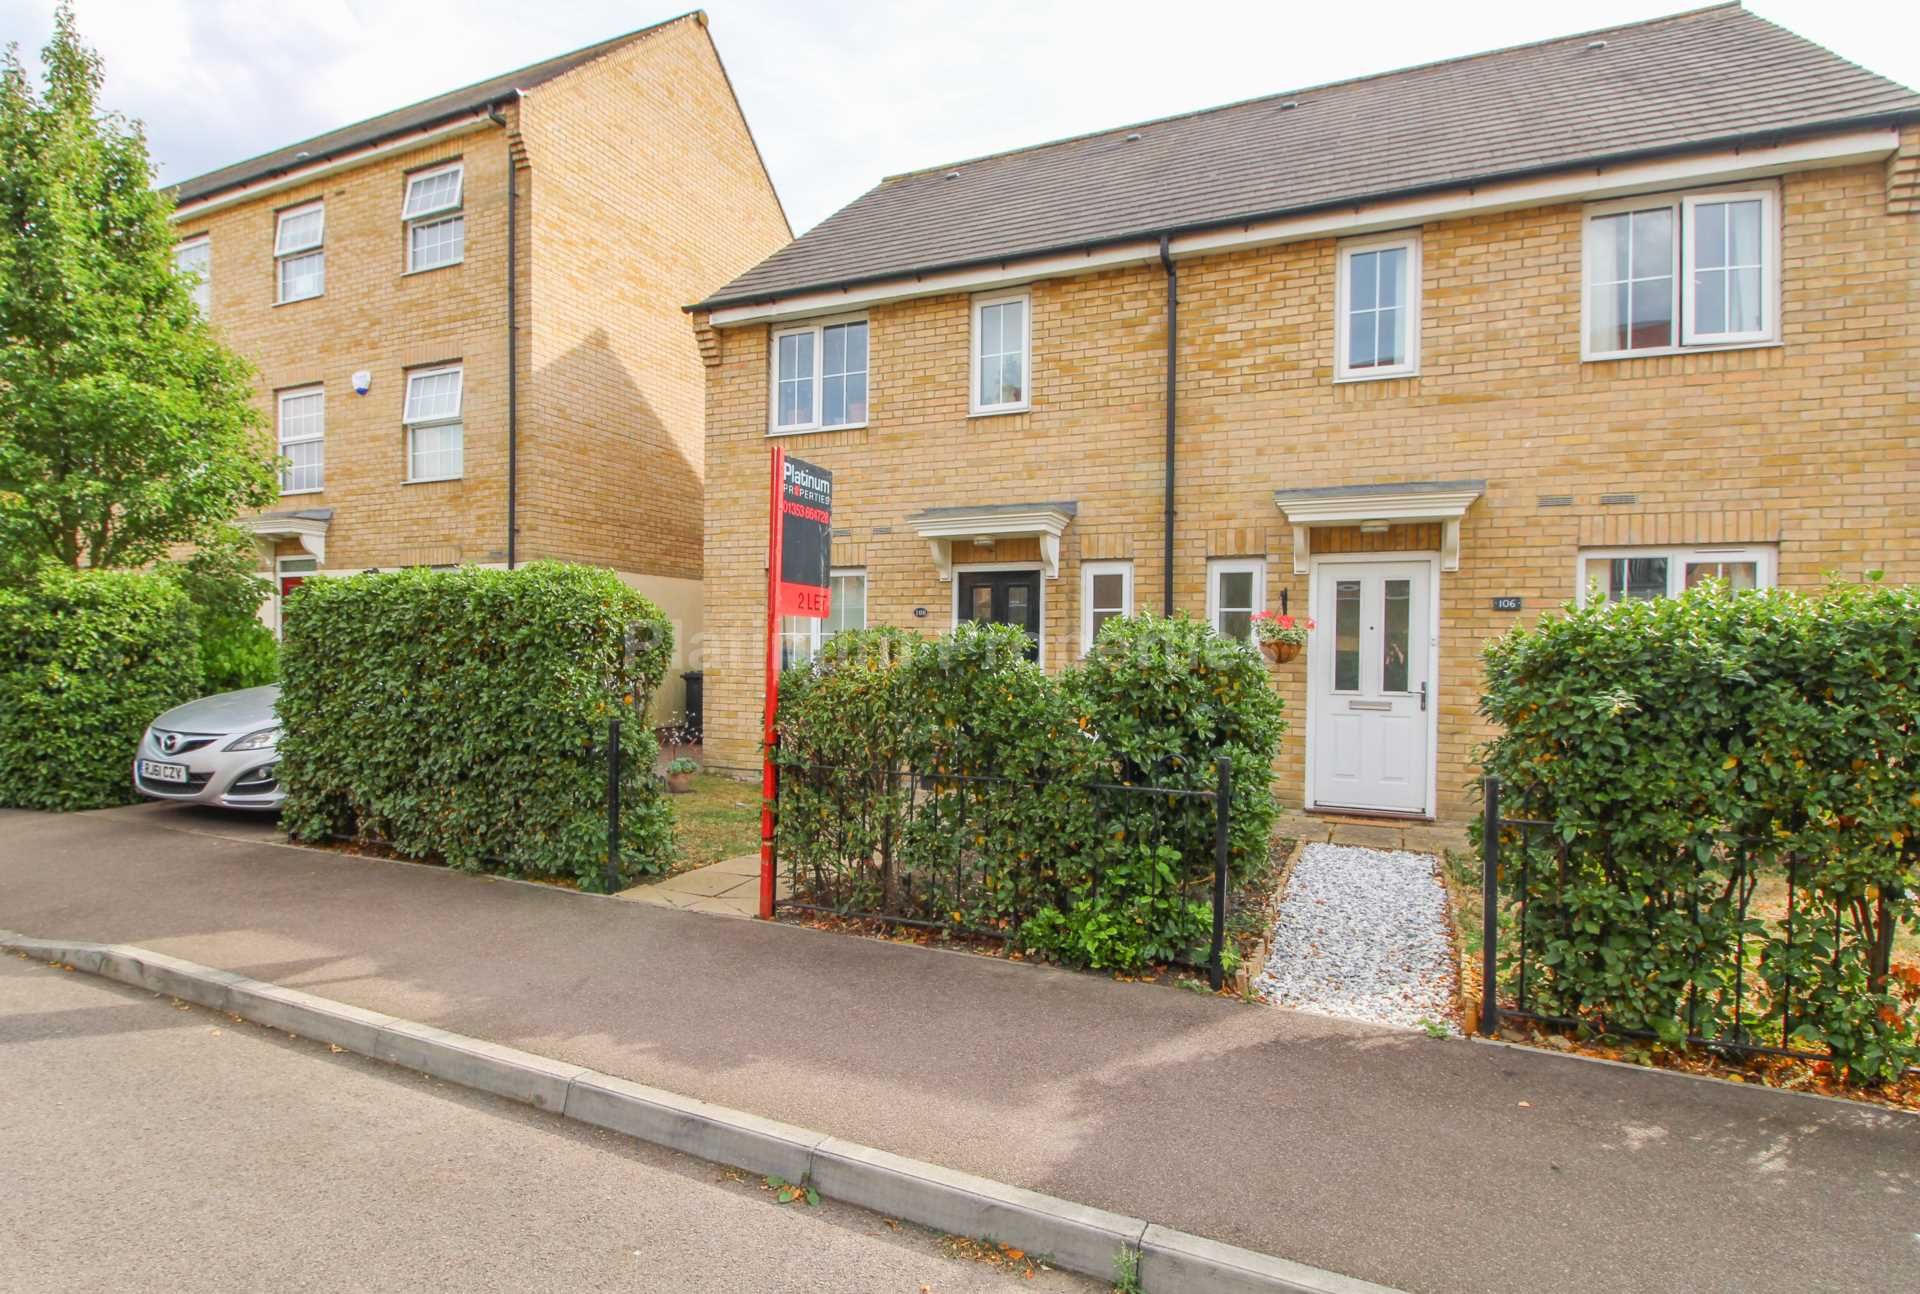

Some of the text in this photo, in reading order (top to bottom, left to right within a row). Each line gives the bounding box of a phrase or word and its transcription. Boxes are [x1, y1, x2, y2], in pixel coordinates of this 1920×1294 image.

[784, 462, 830, 495] Platinum
[783, 483, 830, 505] PROPERTIES
[798, 592, 827, 611] 2 LET
[1499, 599, 1517, 609] 106
